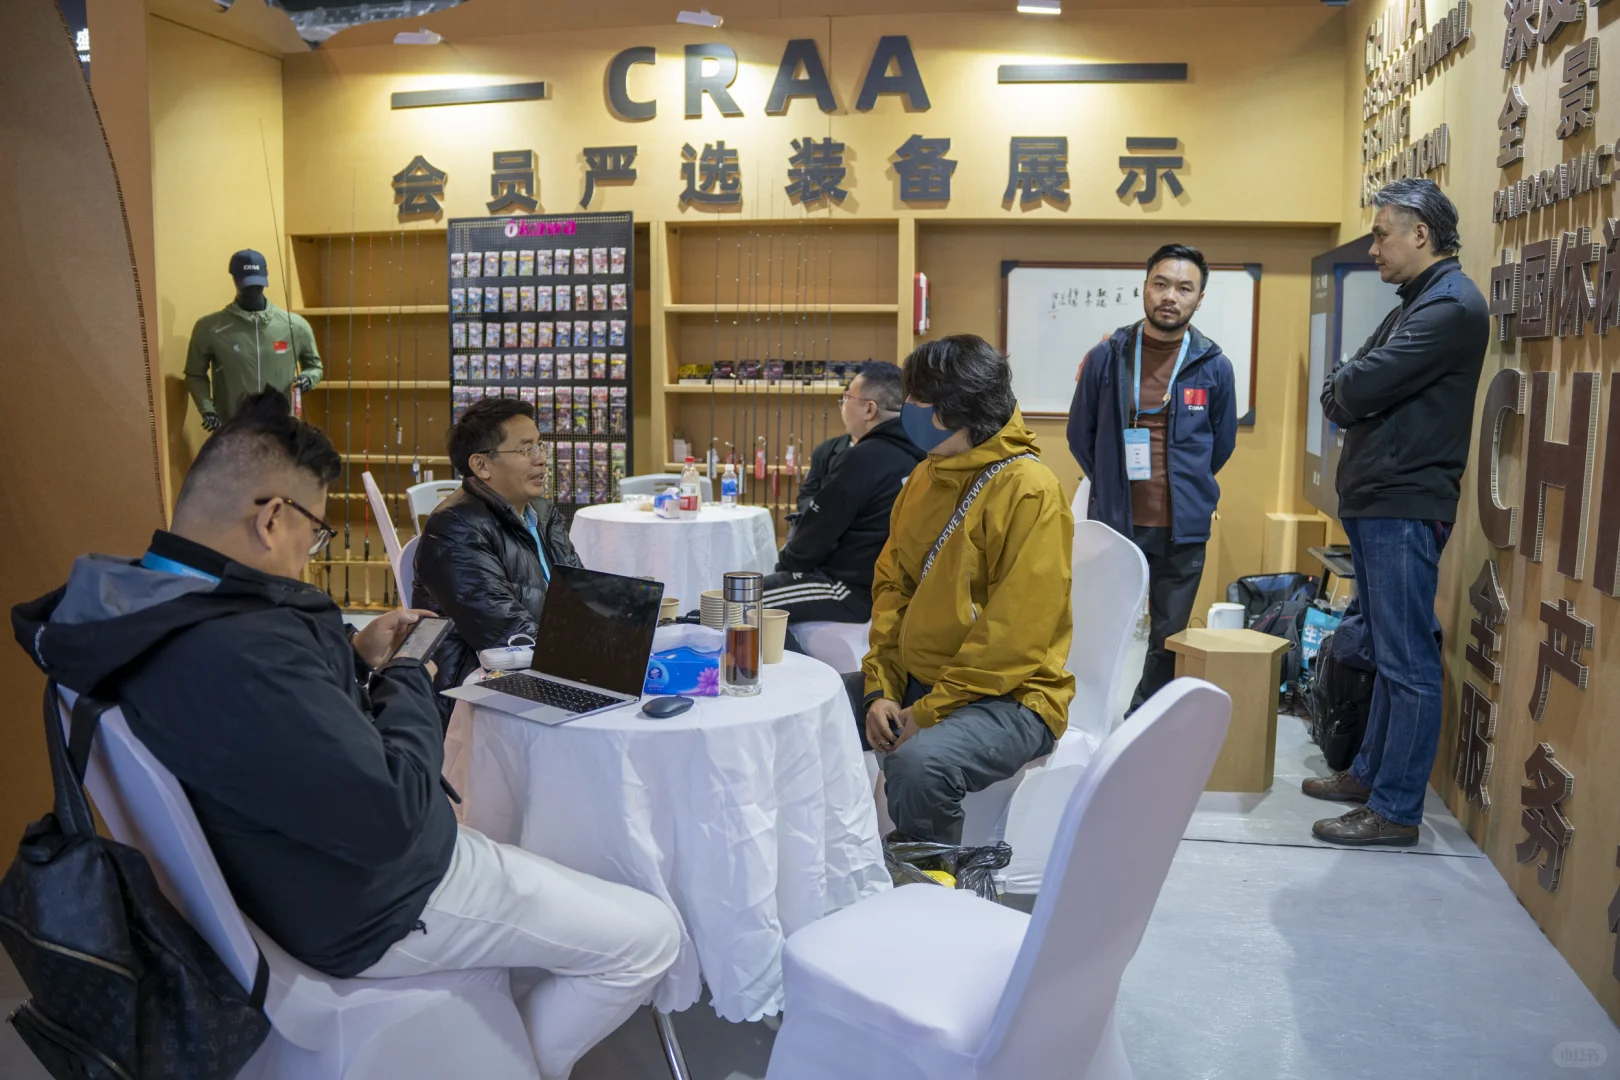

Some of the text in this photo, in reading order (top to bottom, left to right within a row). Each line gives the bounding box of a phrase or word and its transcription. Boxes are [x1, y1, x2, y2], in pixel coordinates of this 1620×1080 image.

[607, 35, 931, 120] CRAA
[393, 133, 1184, 214] 会员严选装备展示
